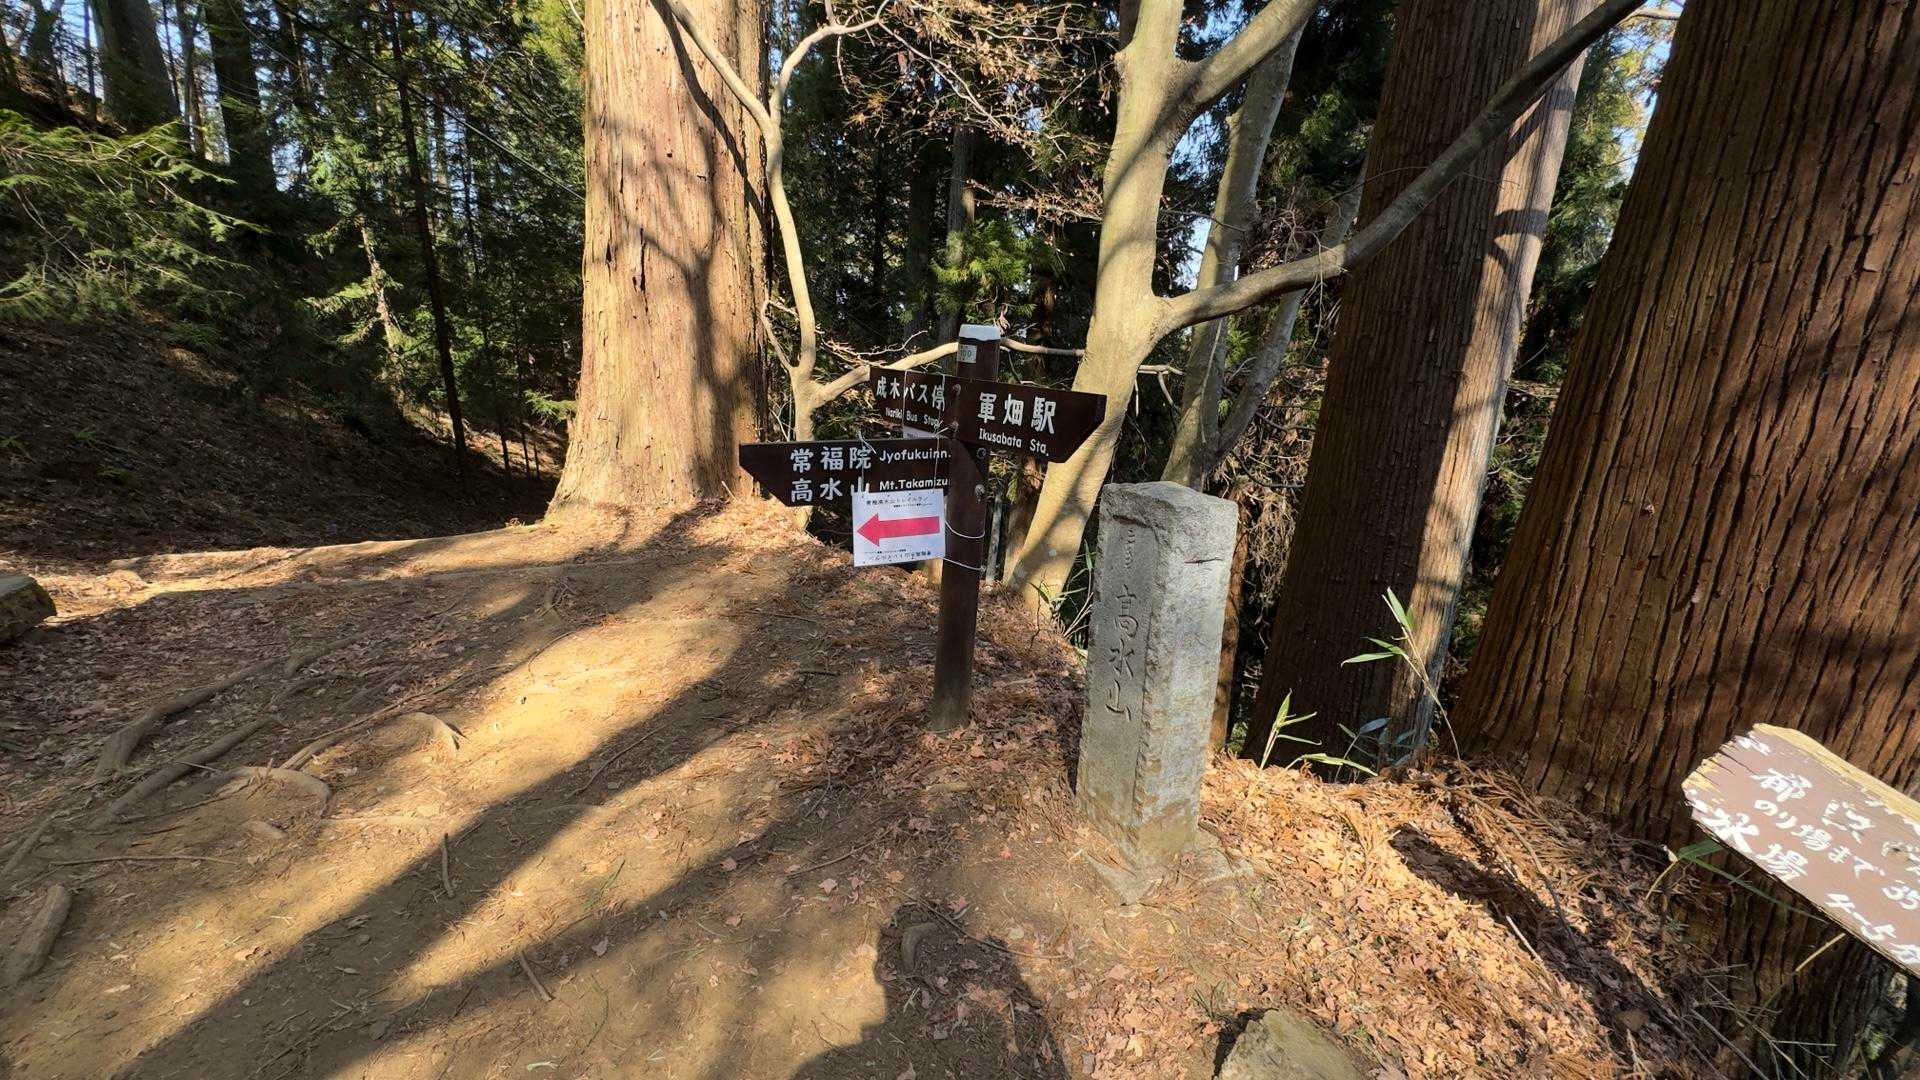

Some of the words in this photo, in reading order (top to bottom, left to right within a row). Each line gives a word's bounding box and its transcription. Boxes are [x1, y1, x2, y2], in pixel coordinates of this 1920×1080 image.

[876, 376, 945, 411] 成木バス停
[906, 410, 918, 422] Bus
[977, 392, 1056, 434] 軍畑駅
[979, 428, 1022, 448] Ikusabata
[1030, 438, 1049, 457] Sta.
[789, 446, 872, 473] 常福院
[791, 476, 870, 503] 高水山
